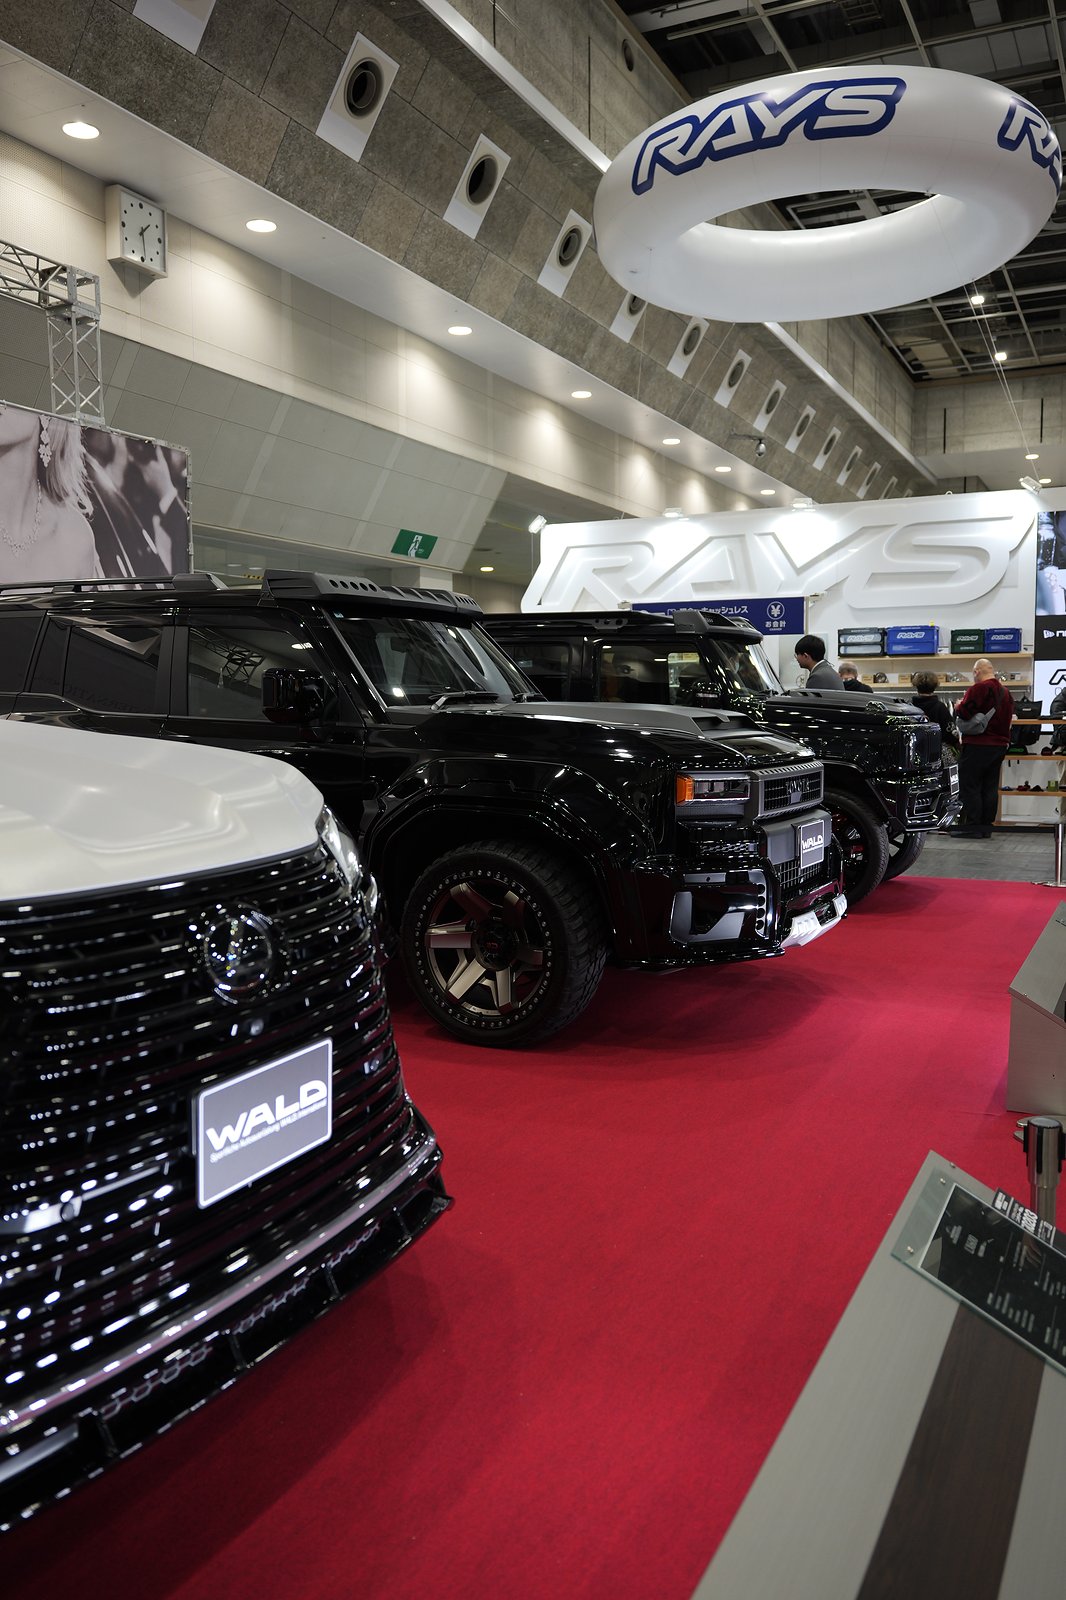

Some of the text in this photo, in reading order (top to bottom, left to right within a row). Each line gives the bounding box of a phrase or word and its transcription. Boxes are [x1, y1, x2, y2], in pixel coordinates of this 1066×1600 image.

[632, 77, 906, 195] RAYS
[528, 503, 1030, 612] RAYS
[896, 631, 926, 639] RAYS
[801, 834, 824, 850] WALD
[206, 1080, 328, 1152] WALD
